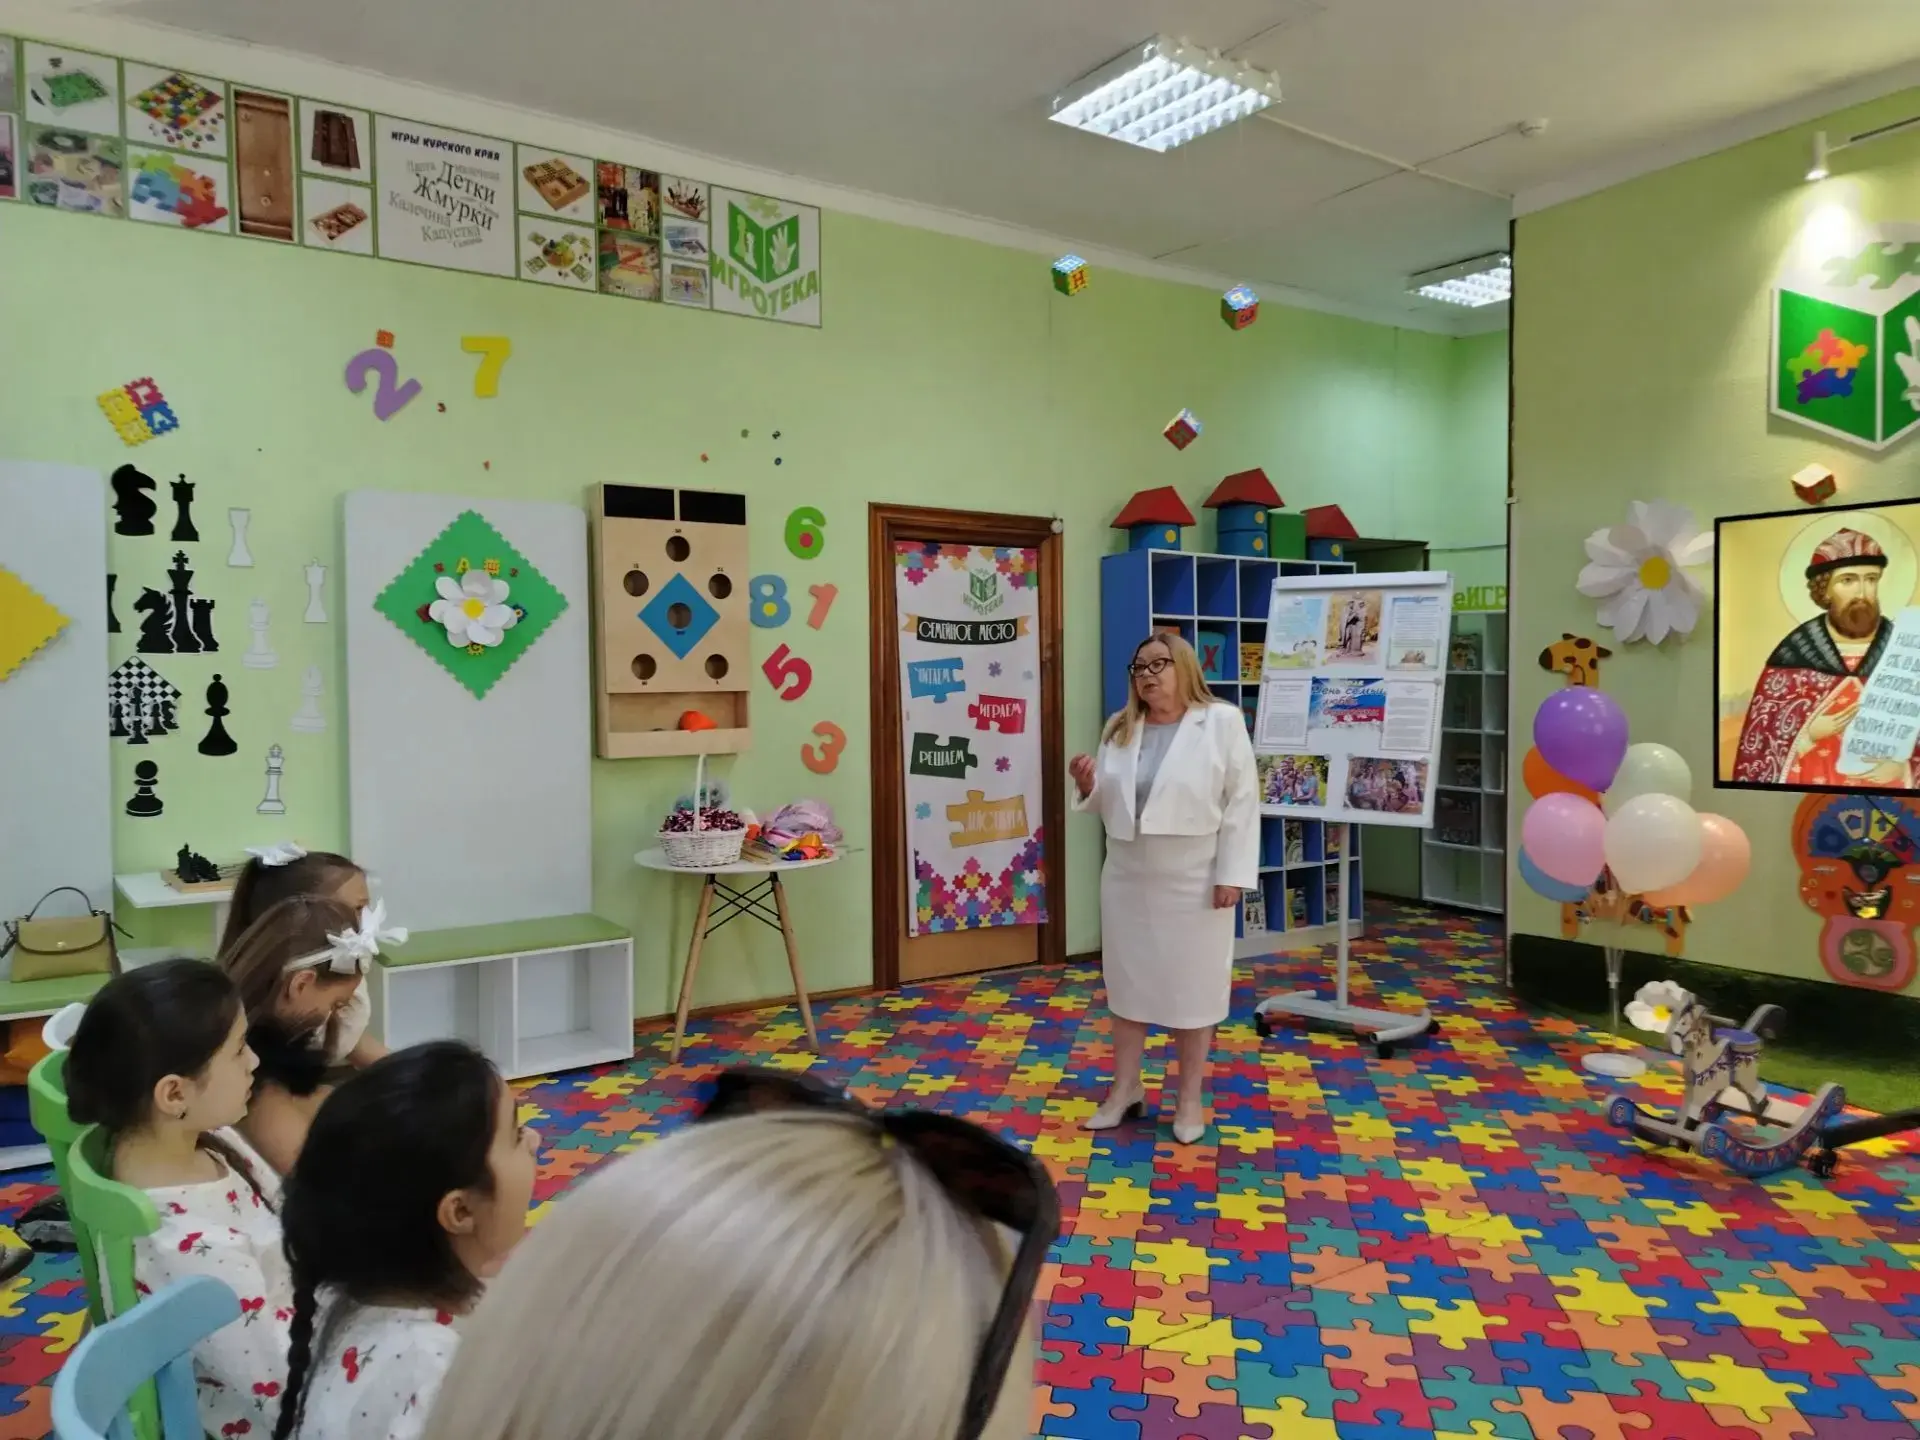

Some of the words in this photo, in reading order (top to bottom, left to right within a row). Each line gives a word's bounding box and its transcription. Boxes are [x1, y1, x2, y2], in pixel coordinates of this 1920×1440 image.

[391, 131, 420, 145] ИГРЫ
[423, 137, 471, 156] КУРСКОГО
[475, 147, 500, 161] КРАЯ
[413, 174, 493, 231] Жмурки
[436, 161, 497, 205] Детки
[711, 251, 818, 316] ИГРОТЕКА
[344, 348, 422, 421] 2
[461, 336, 511, 398] 7
[784, 506, 827, 560] 6
[749, 575, 792, 629] 8
[806, 583, 838, 631] 1
[918, 621, 972, 642] СЕМЕЙНОЕ
[978, 623, 1015, 642] МЕСТО
[761, 643, 812, 702] 5
[979, 702, 1022, 718] ИГРАЕМ
[801, 720, 847, 775] 3
[919, 749, 965, 767] РЕШАЕМ
